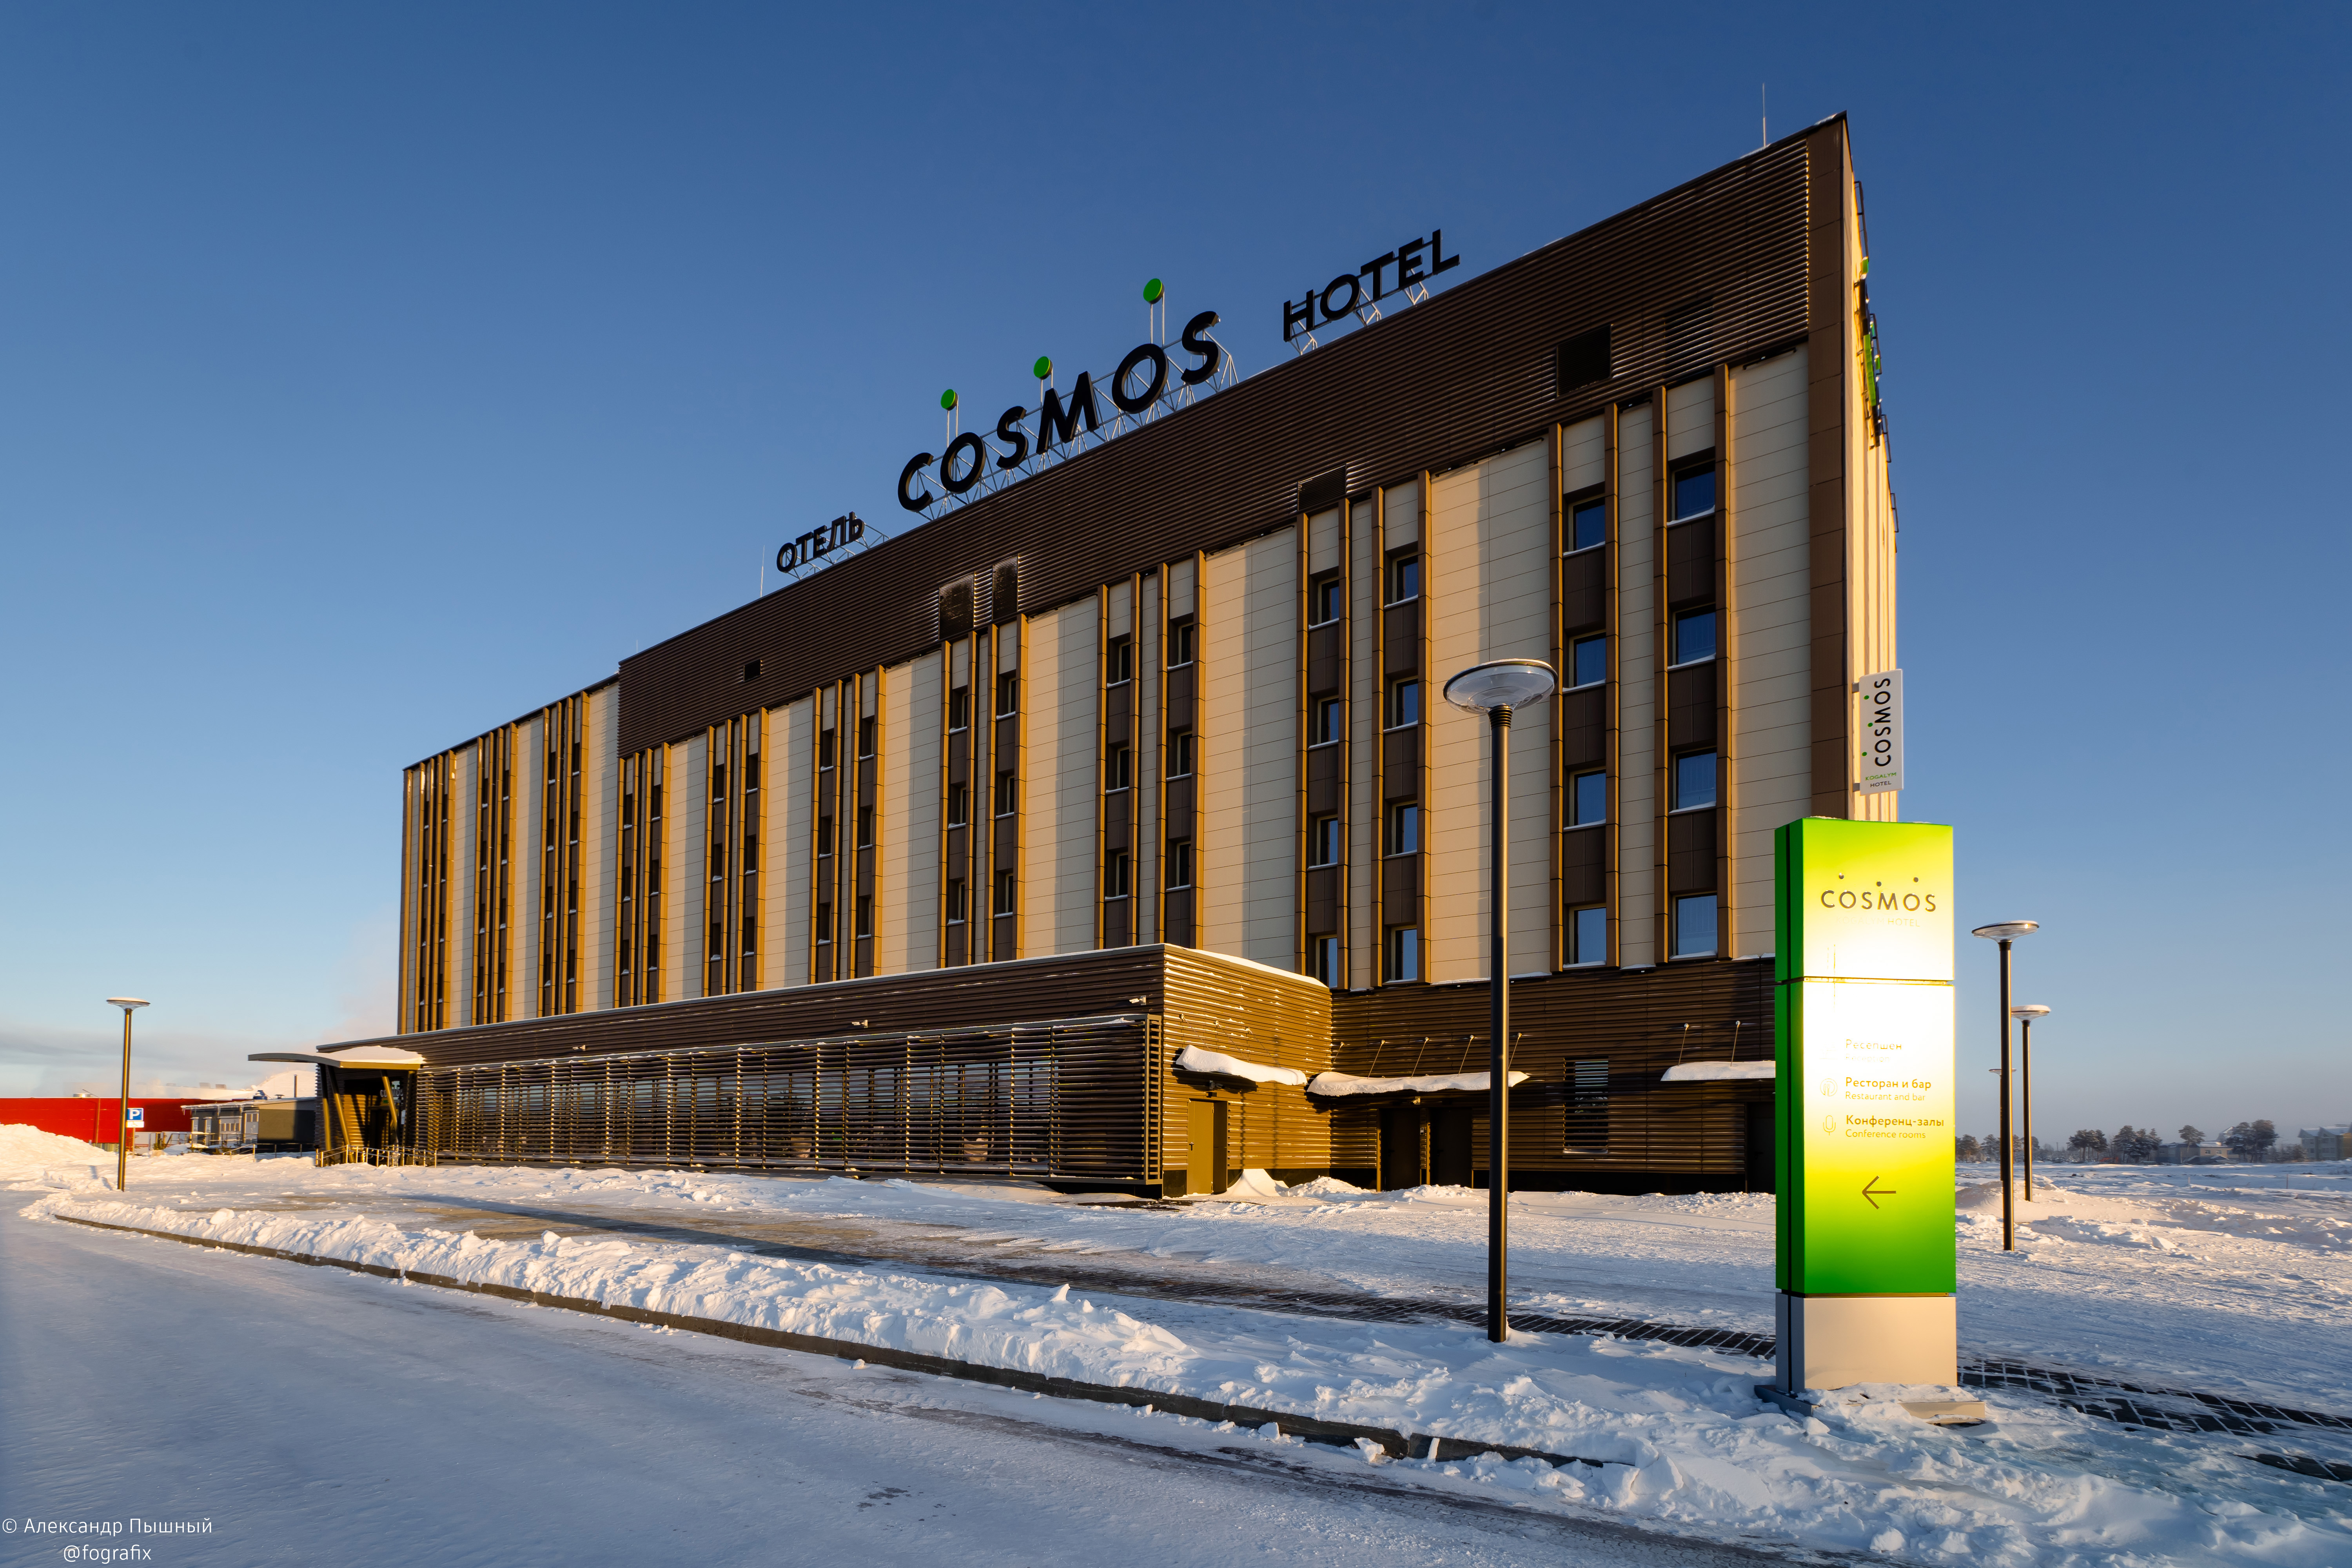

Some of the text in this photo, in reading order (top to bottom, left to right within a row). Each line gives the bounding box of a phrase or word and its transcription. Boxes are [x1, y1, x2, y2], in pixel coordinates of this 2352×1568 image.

[777, 229, 1461, 573] ОТЕЛЬ COSMOS HOTEL
[1874, 678, 1891, 767] COSMOS
[1865, 772, 1896, 780] KOGALYM
[1821, 889, 1936, 912] COSMOS
[1888, 918, 1920, 927] HOTEL
[1846, 1039, 1902, 1050] Ресепшен
[1846, 1077, 1898, 1090] Ресторан
[1911, 1079, 1932, 1091] бар
[1845, 1091, 1892, 1100] Restaurant
[129, 1109, 140, 1120] P
[1846, 1115, 1944, 1128] Конференц-залы
[1845, 1129, 1896, 1138] Conference
